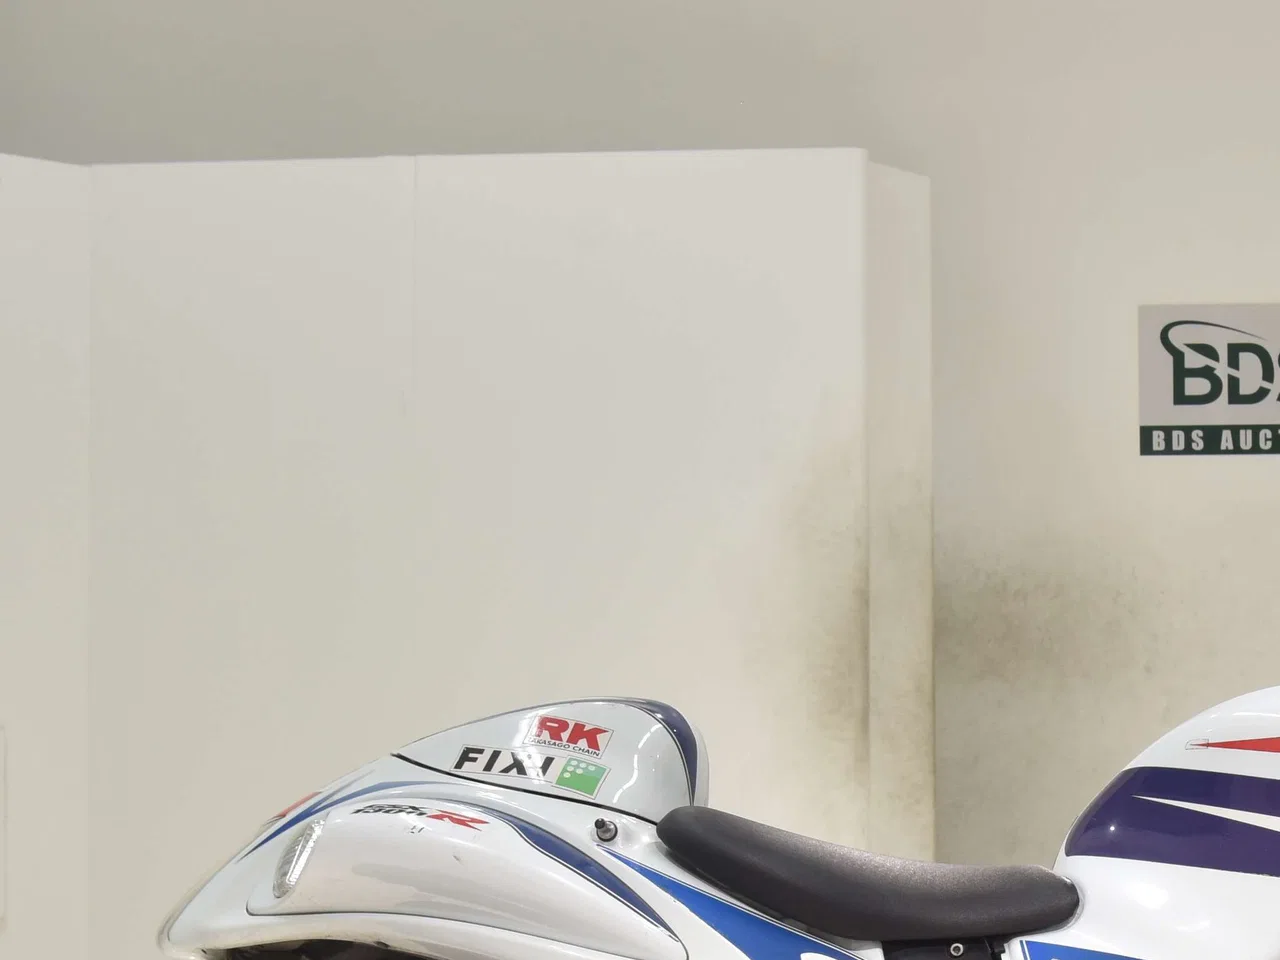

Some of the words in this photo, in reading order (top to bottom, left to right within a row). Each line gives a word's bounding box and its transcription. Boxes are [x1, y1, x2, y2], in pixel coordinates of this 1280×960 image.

[1152, 429, 1204, 451] BDS
[534, 715, 609, 752] RK
[453, 746, 555, 778] FIXI
[572, 745, 601, 758] CHAIN
